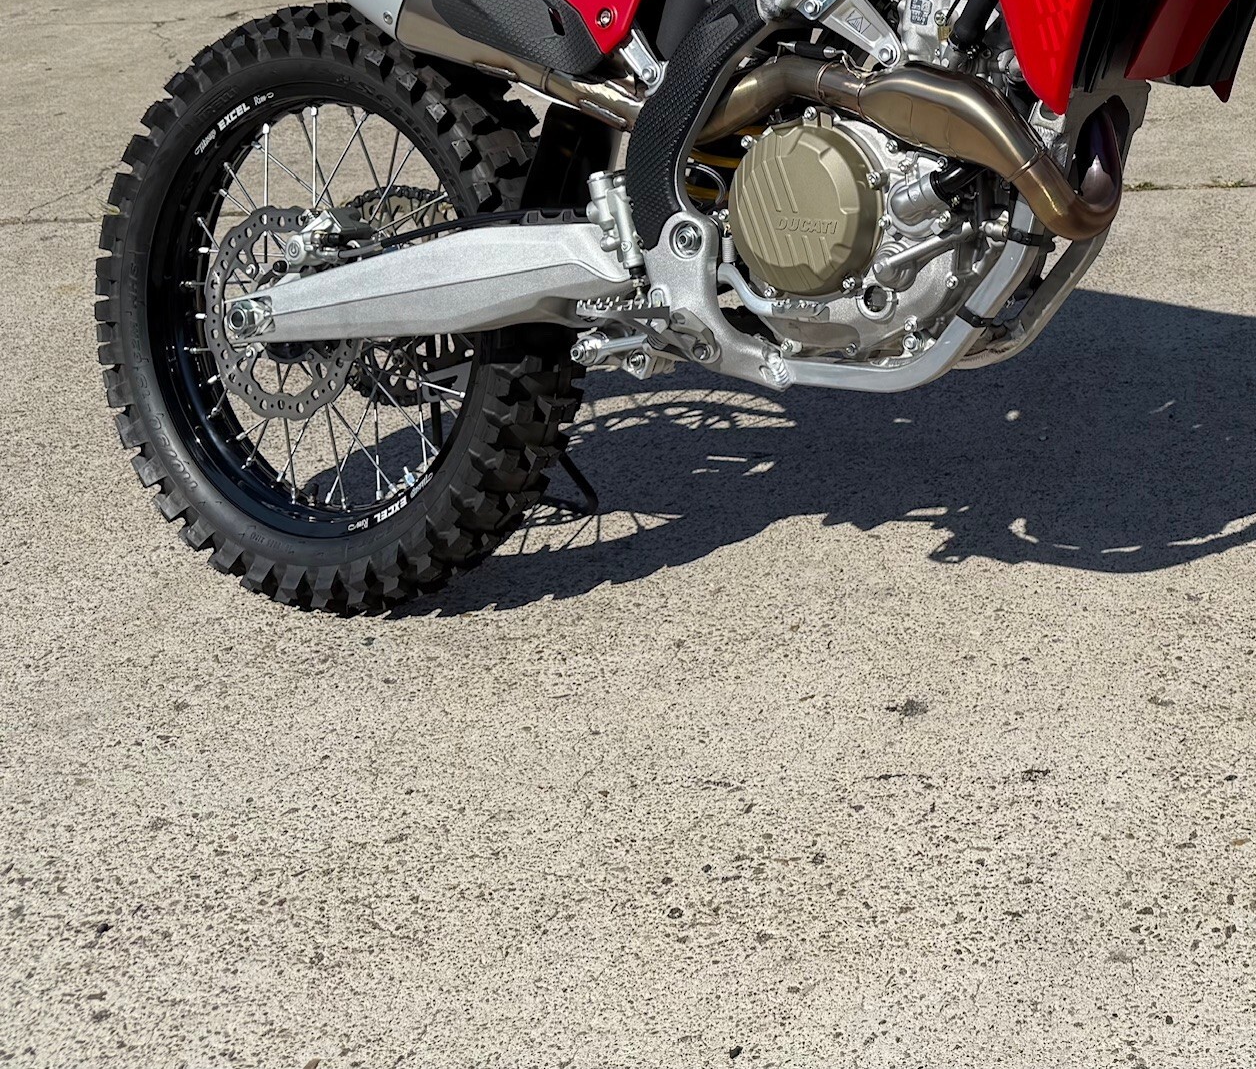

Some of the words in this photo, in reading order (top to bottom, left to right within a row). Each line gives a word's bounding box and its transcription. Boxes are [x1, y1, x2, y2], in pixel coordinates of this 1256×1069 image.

[217, 103, 250, 131] EXCEL
[253, 92, 274, 106] Rim
[775, 218, 838, 235] DUCATI
[374, 496, 408, 523] EXCEL
